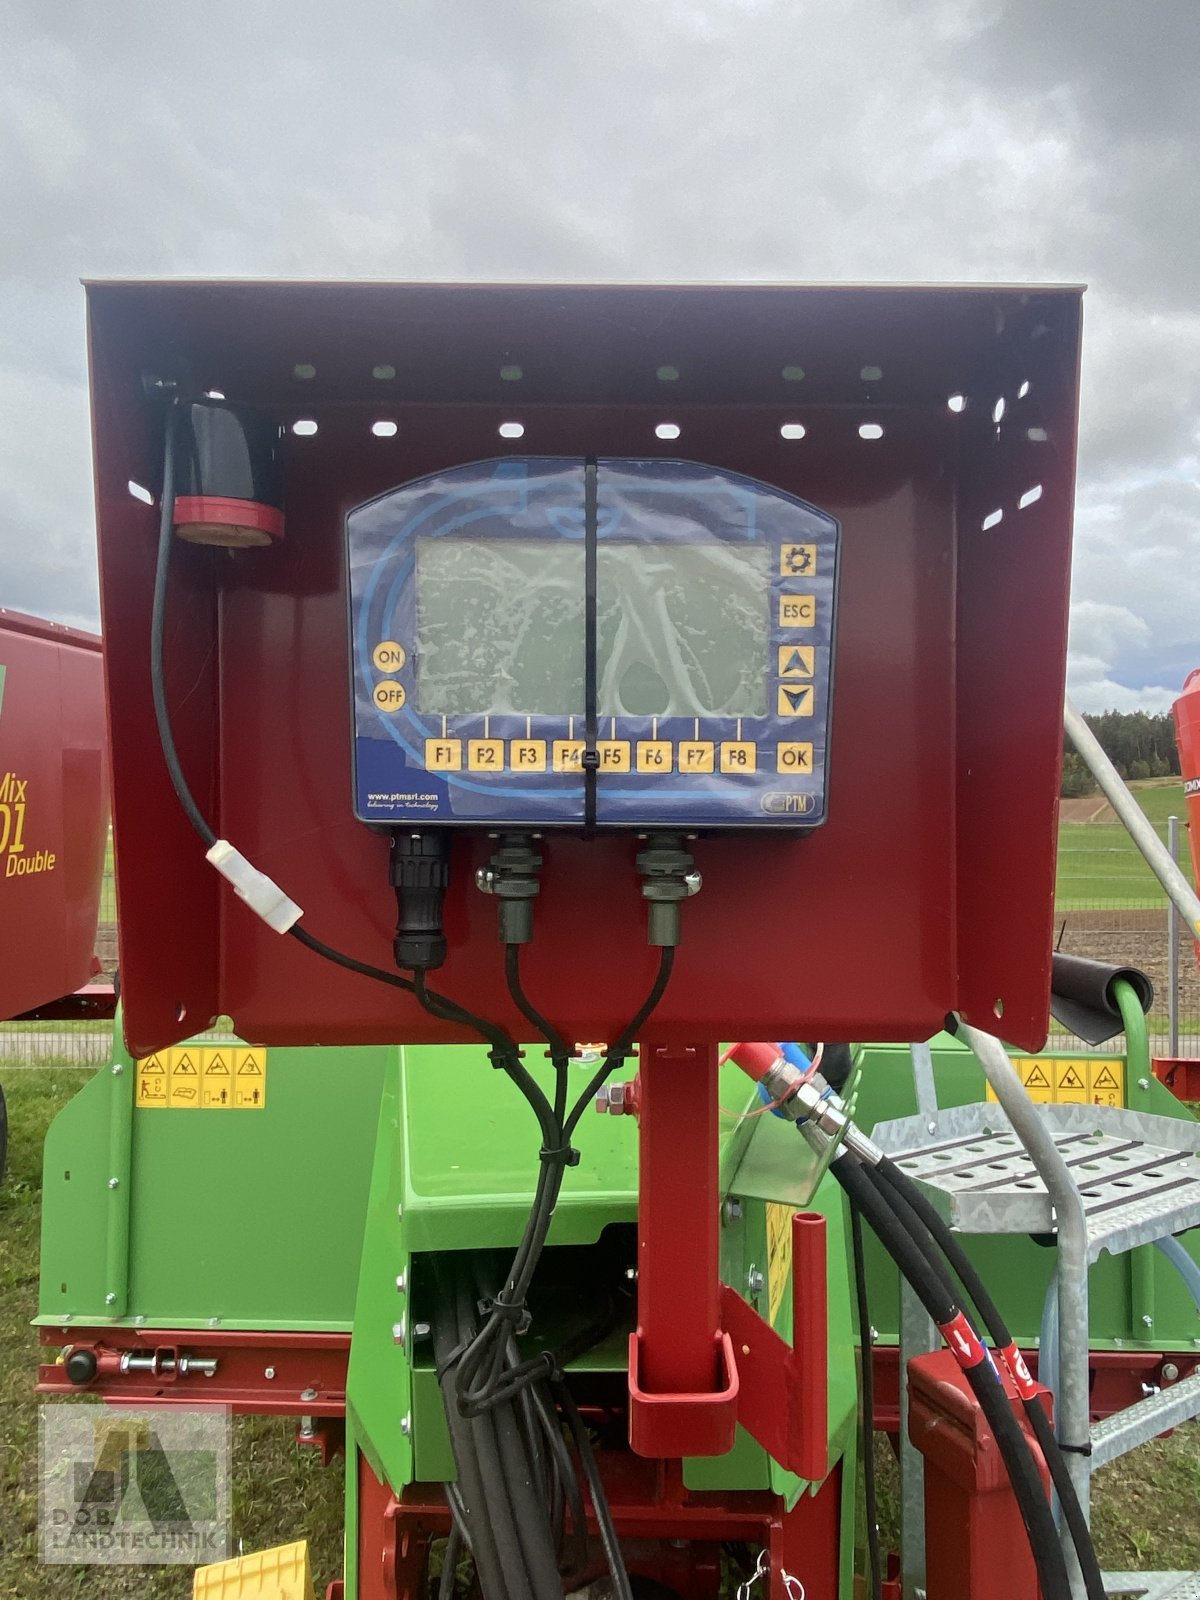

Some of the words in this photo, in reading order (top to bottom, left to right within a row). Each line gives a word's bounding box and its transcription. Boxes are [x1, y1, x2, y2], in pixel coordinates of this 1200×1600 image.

[783, 604, 811, 618] ESC
[378, 650, 401, 664] ON
[376, 689, 403, 703] OFF
[435, 747, 452, 763] F1
[476, 747, 495, 764] F2
[519, 748, 537, 764] F3
[561, 748, 580, 765] F4
[603, 748, 622, 765] F5
[645, 749, 663, 765] F6
[687, 749, 706, 766] F7
[729, 749, 747, 766] F8
[782, 750, 808, 766] OK
[367, 793, 439, 802] www.ptmsrl.com
[5, 850, 56, 878] Double
